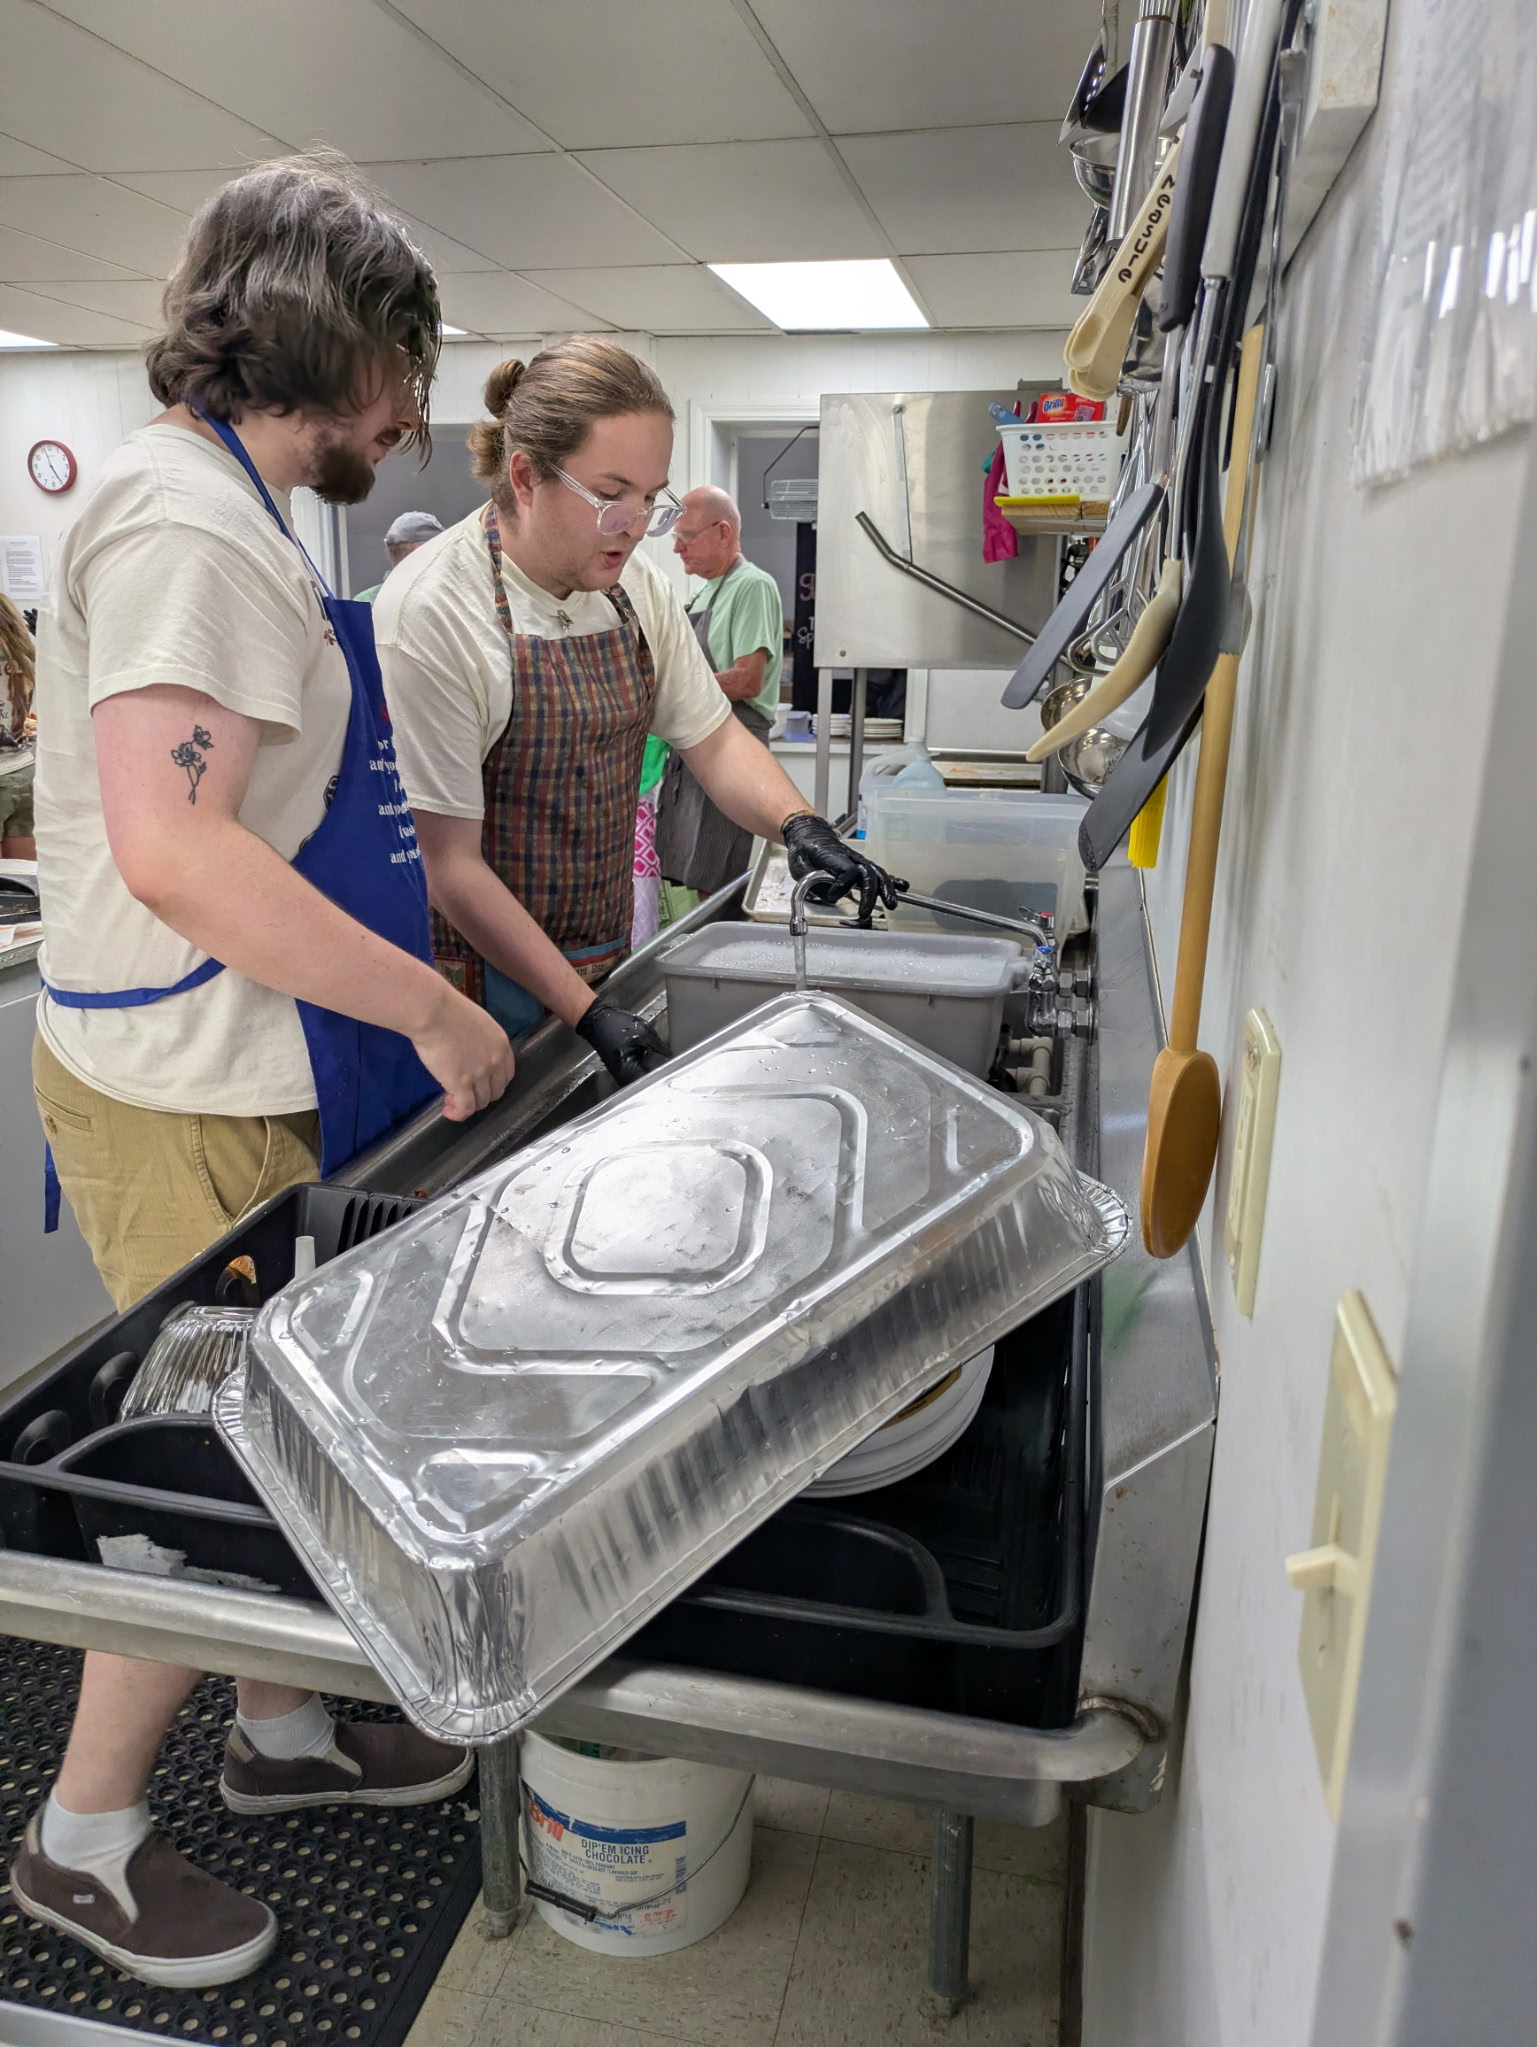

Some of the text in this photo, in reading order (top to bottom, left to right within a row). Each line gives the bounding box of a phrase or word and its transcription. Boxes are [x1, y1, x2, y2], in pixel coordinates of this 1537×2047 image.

[1117, 173, 1176, 284] Measure
[1043, 398, 1065, 412] Brillo
[389, 849, 407, 864] and
[529, 1800, 565, 1842] Brill
[581, 1838, 649, 1856] DIP'EM ICING
[585, 1849, 645, 1865] CHOCOLATE
